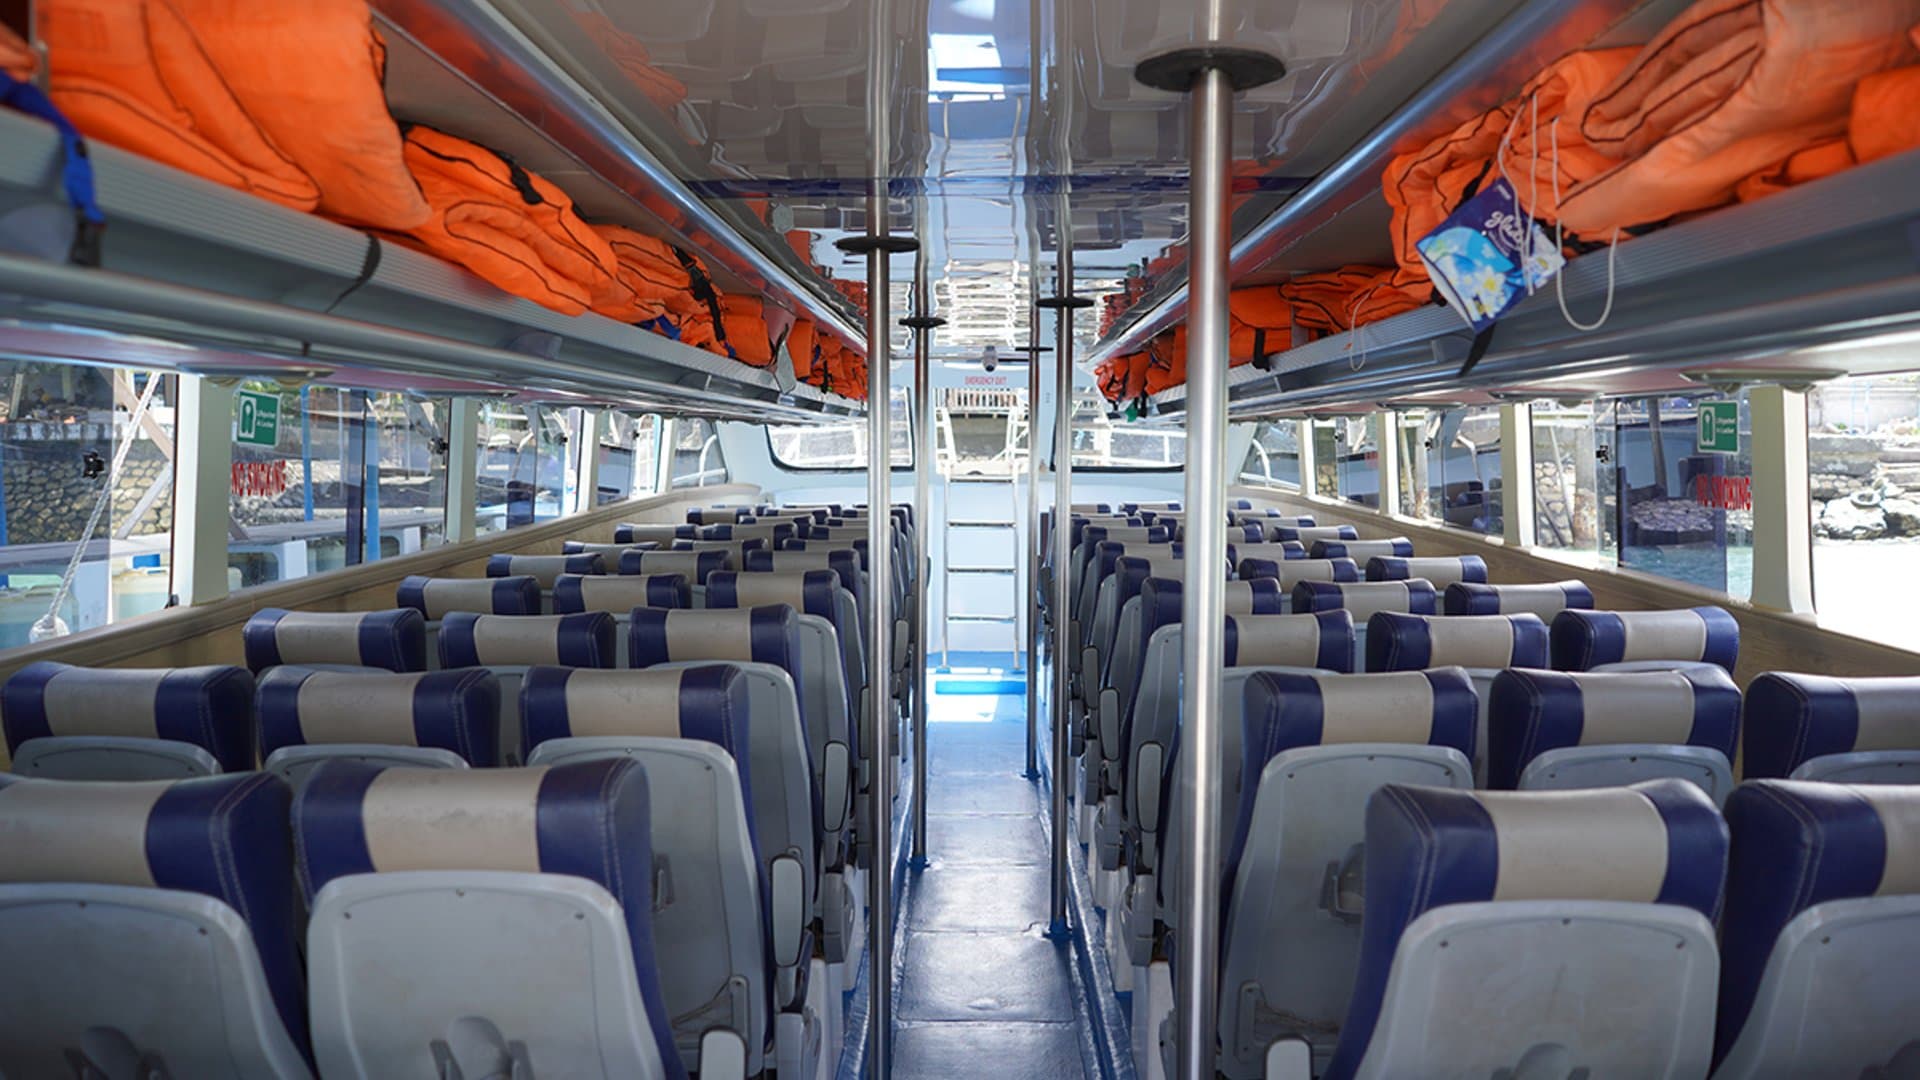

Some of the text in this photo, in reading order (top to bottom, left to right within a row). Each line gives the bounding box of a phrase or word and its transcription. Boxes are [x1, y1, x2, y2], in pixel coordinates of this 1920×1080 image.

[231, 459, 286, 497] NO SMOKING
[1711, 475, 1751, 511] SMOKING
